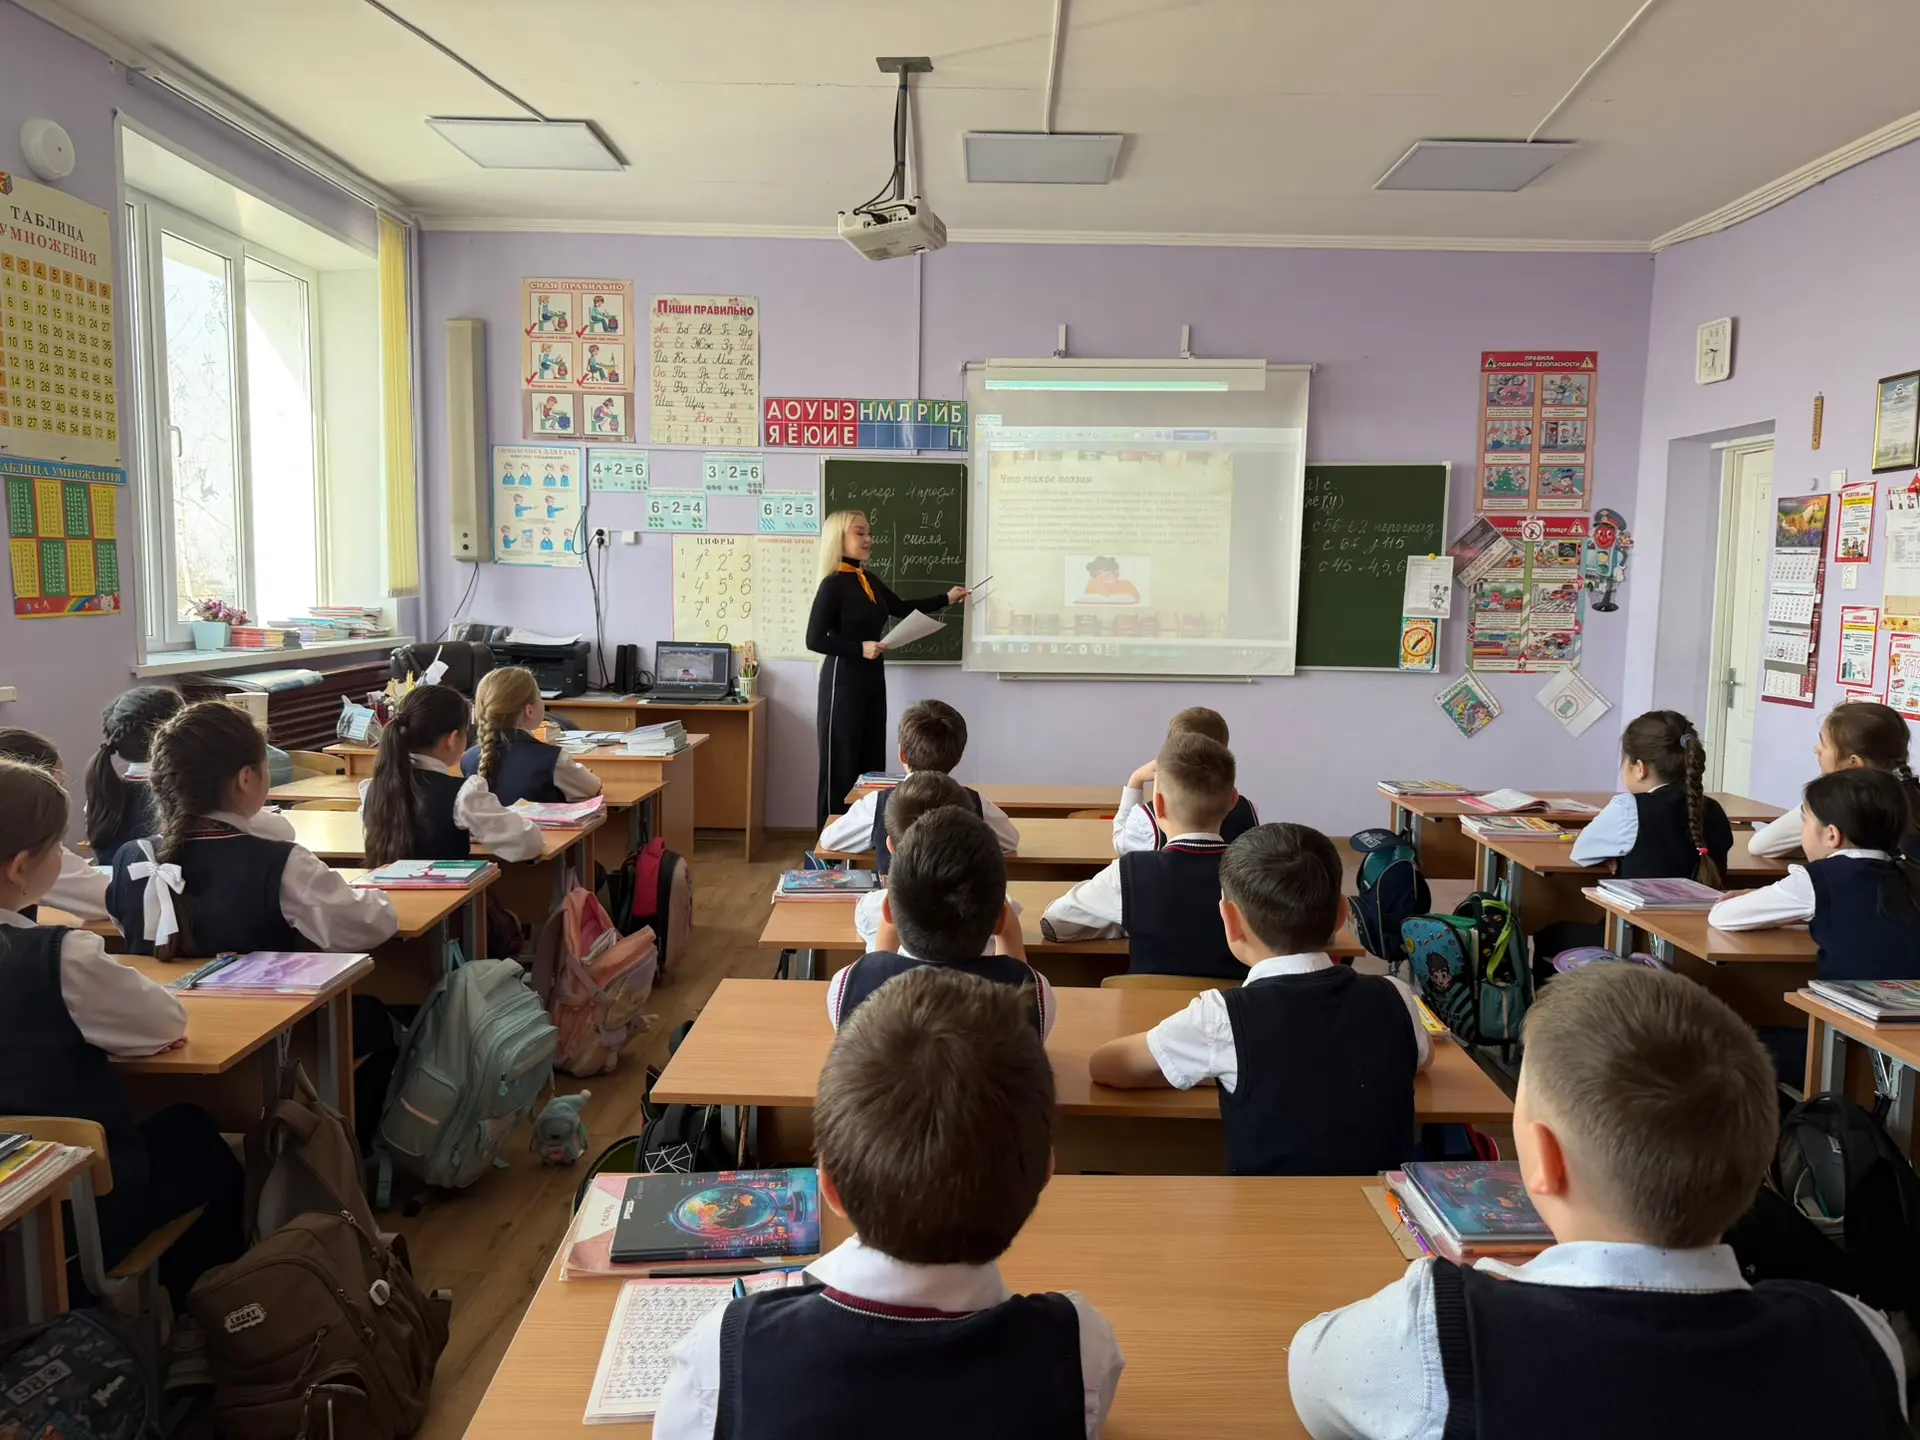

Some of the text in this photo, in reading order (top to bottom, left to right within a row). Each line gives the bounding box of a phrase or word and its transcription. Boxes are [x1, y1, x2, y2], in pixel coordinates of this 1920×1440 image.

[10, 205, 84, 242] ТАБЛИЦА
[0, 223, 97, 265] УМНОЖЕНИЯ
[4, 256, 107, 296] 2 3 4 5 6 7 8 9
[529, 281, 624, 292] СИДИ ПРАВИЛЬНО
[5, 277, 110, 315] 4 6 8 10 12 14 16 18
[7, 296, 111, 332] 6 9 12 15 18 21 24 27
[693, 304, 754, 316] ПРАВИЛЬНО
[8, 336, 113, 369] 10 15 20 25 30 35 40 45
[13, 415, 116, 440] 18 27 36 45 54 63 72 81
[999, 474, 1093, 485] Что такое поэзия
[696, 537, 735, 545] ЦИФРЫ
[704, 549, 709, 557] 2
[728, 549, 733, 557] 3
[695, 554, 752, 572] 1 2 3
[704, 572, 709, 580] 5
[694, 577, 752, 595] 4 5 6
[705, 596, 710, 604] 8
[729, 596, 734, 604] 9
[694, 600, 752, 619] 7 8 9
[716, 625, 729, 642] 0
